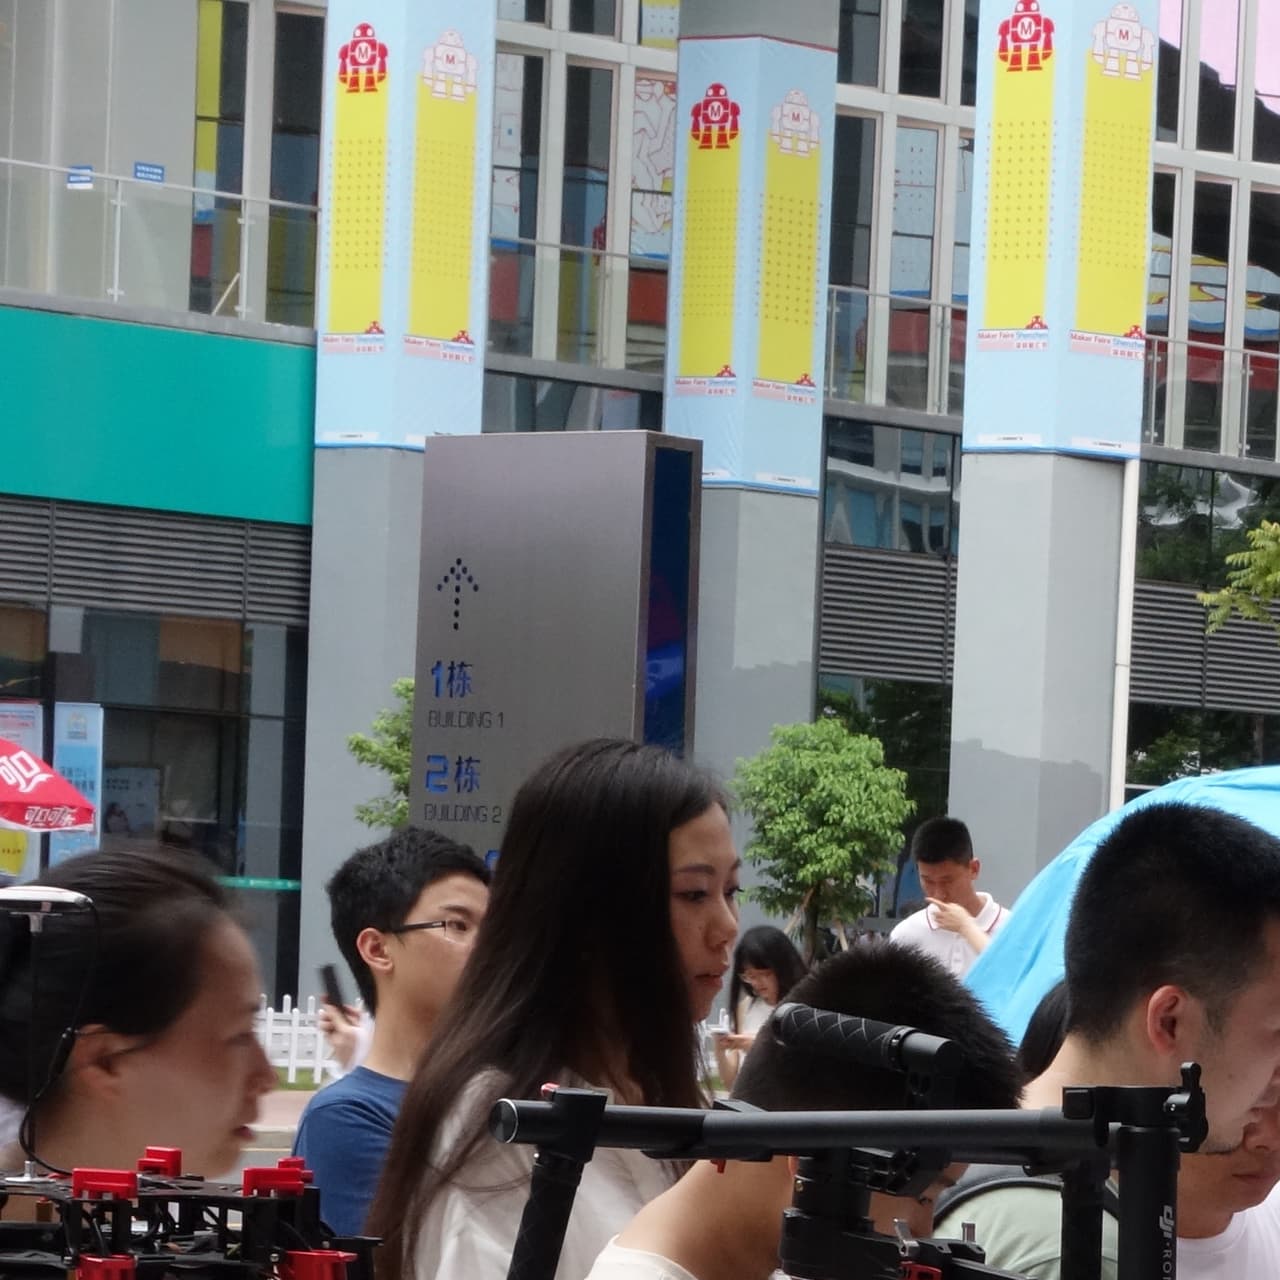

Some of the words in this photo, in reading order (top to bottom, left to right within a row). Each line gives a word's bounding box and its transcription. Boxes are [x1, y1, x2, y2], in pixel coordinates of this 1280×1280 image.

[430, 660, 473, 698] 1栋
[428, 711, 492, 729] BUILDING
[498, 711, 504, 728] 1
[425, 754, 480, 794] 2栋
[424, 804, 488, 822] BUILDING
[491, 806, 501, 824] 2
